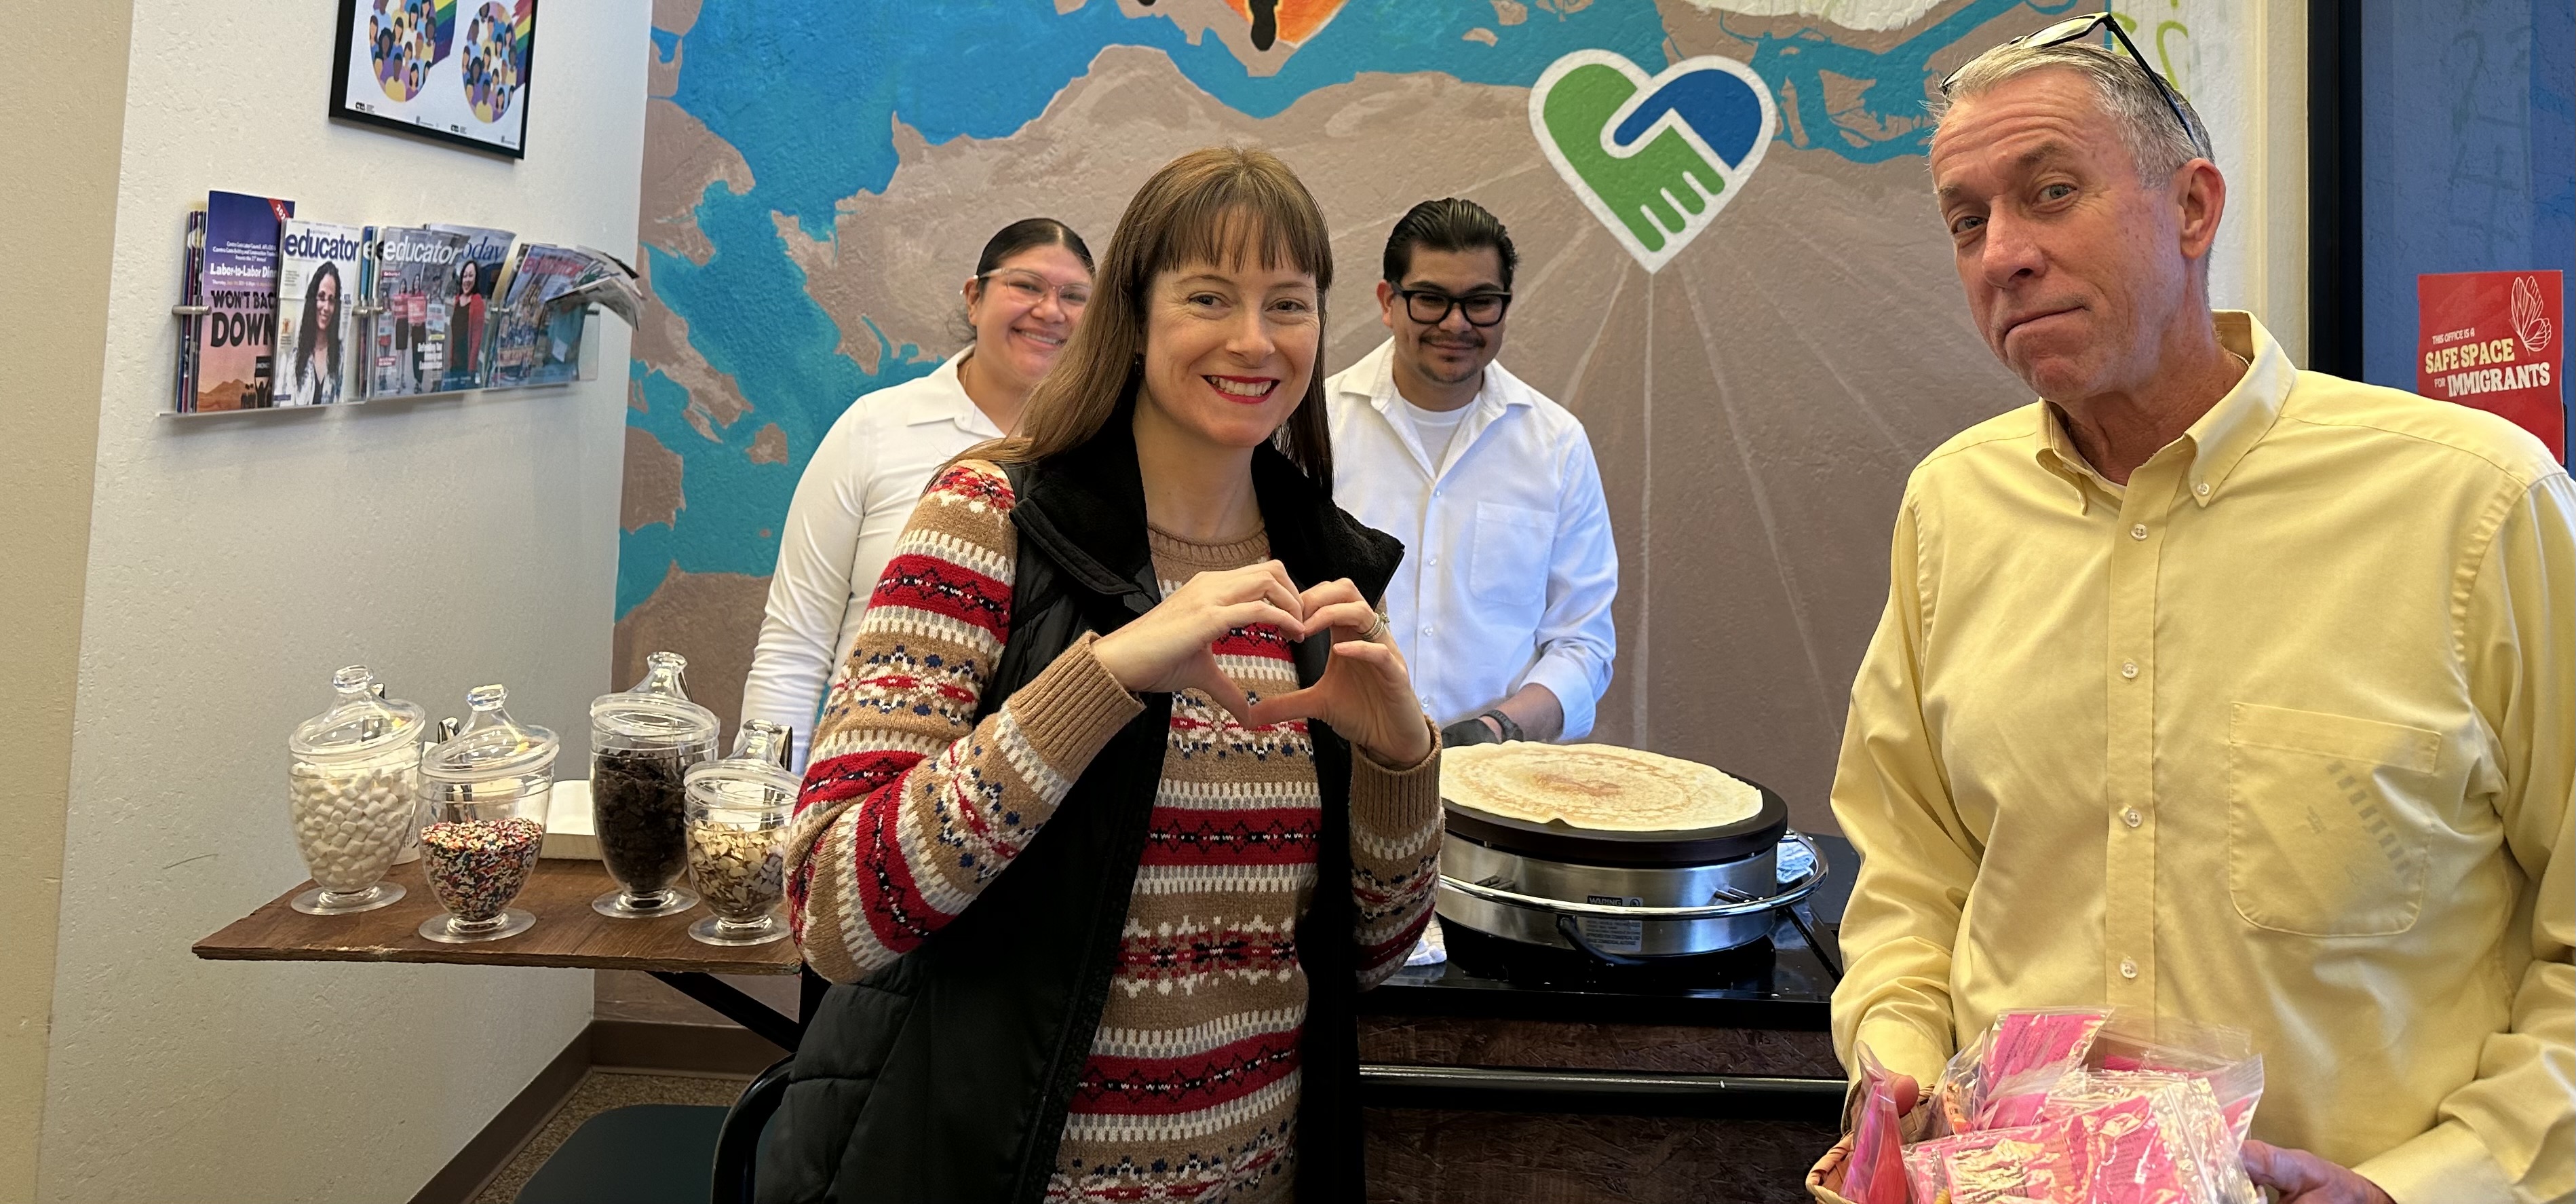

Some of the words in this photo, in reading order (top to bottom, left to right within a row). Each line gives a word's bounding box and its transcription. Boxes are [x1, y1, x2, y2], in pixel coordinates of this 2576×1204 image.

[275, 204, 286, 221] 202
[284, 228, 360, 261] educator
[383, 236, 463, 265] educator
[462, 236, 506, 263] oday
[210, 263, 262, 277] Labor-to-Labor
[210, 290, 250, 308] WON'T
[210, 312, 277, 347] DOWN
[2432, 335, 2444, 345] THIS
[2444, 330, 2463, 343] OFFICE
[2463, 329, 2469, 339] IS
[2469, 327, 2475, 338] A
[2425, 350, 2459, 375] SAFE
[2460, 338, 2515, 368] SPACE
[2434, 377, 2446, 389] FOR
[2448, 362, 2551, 398] IMMIGRANTS
